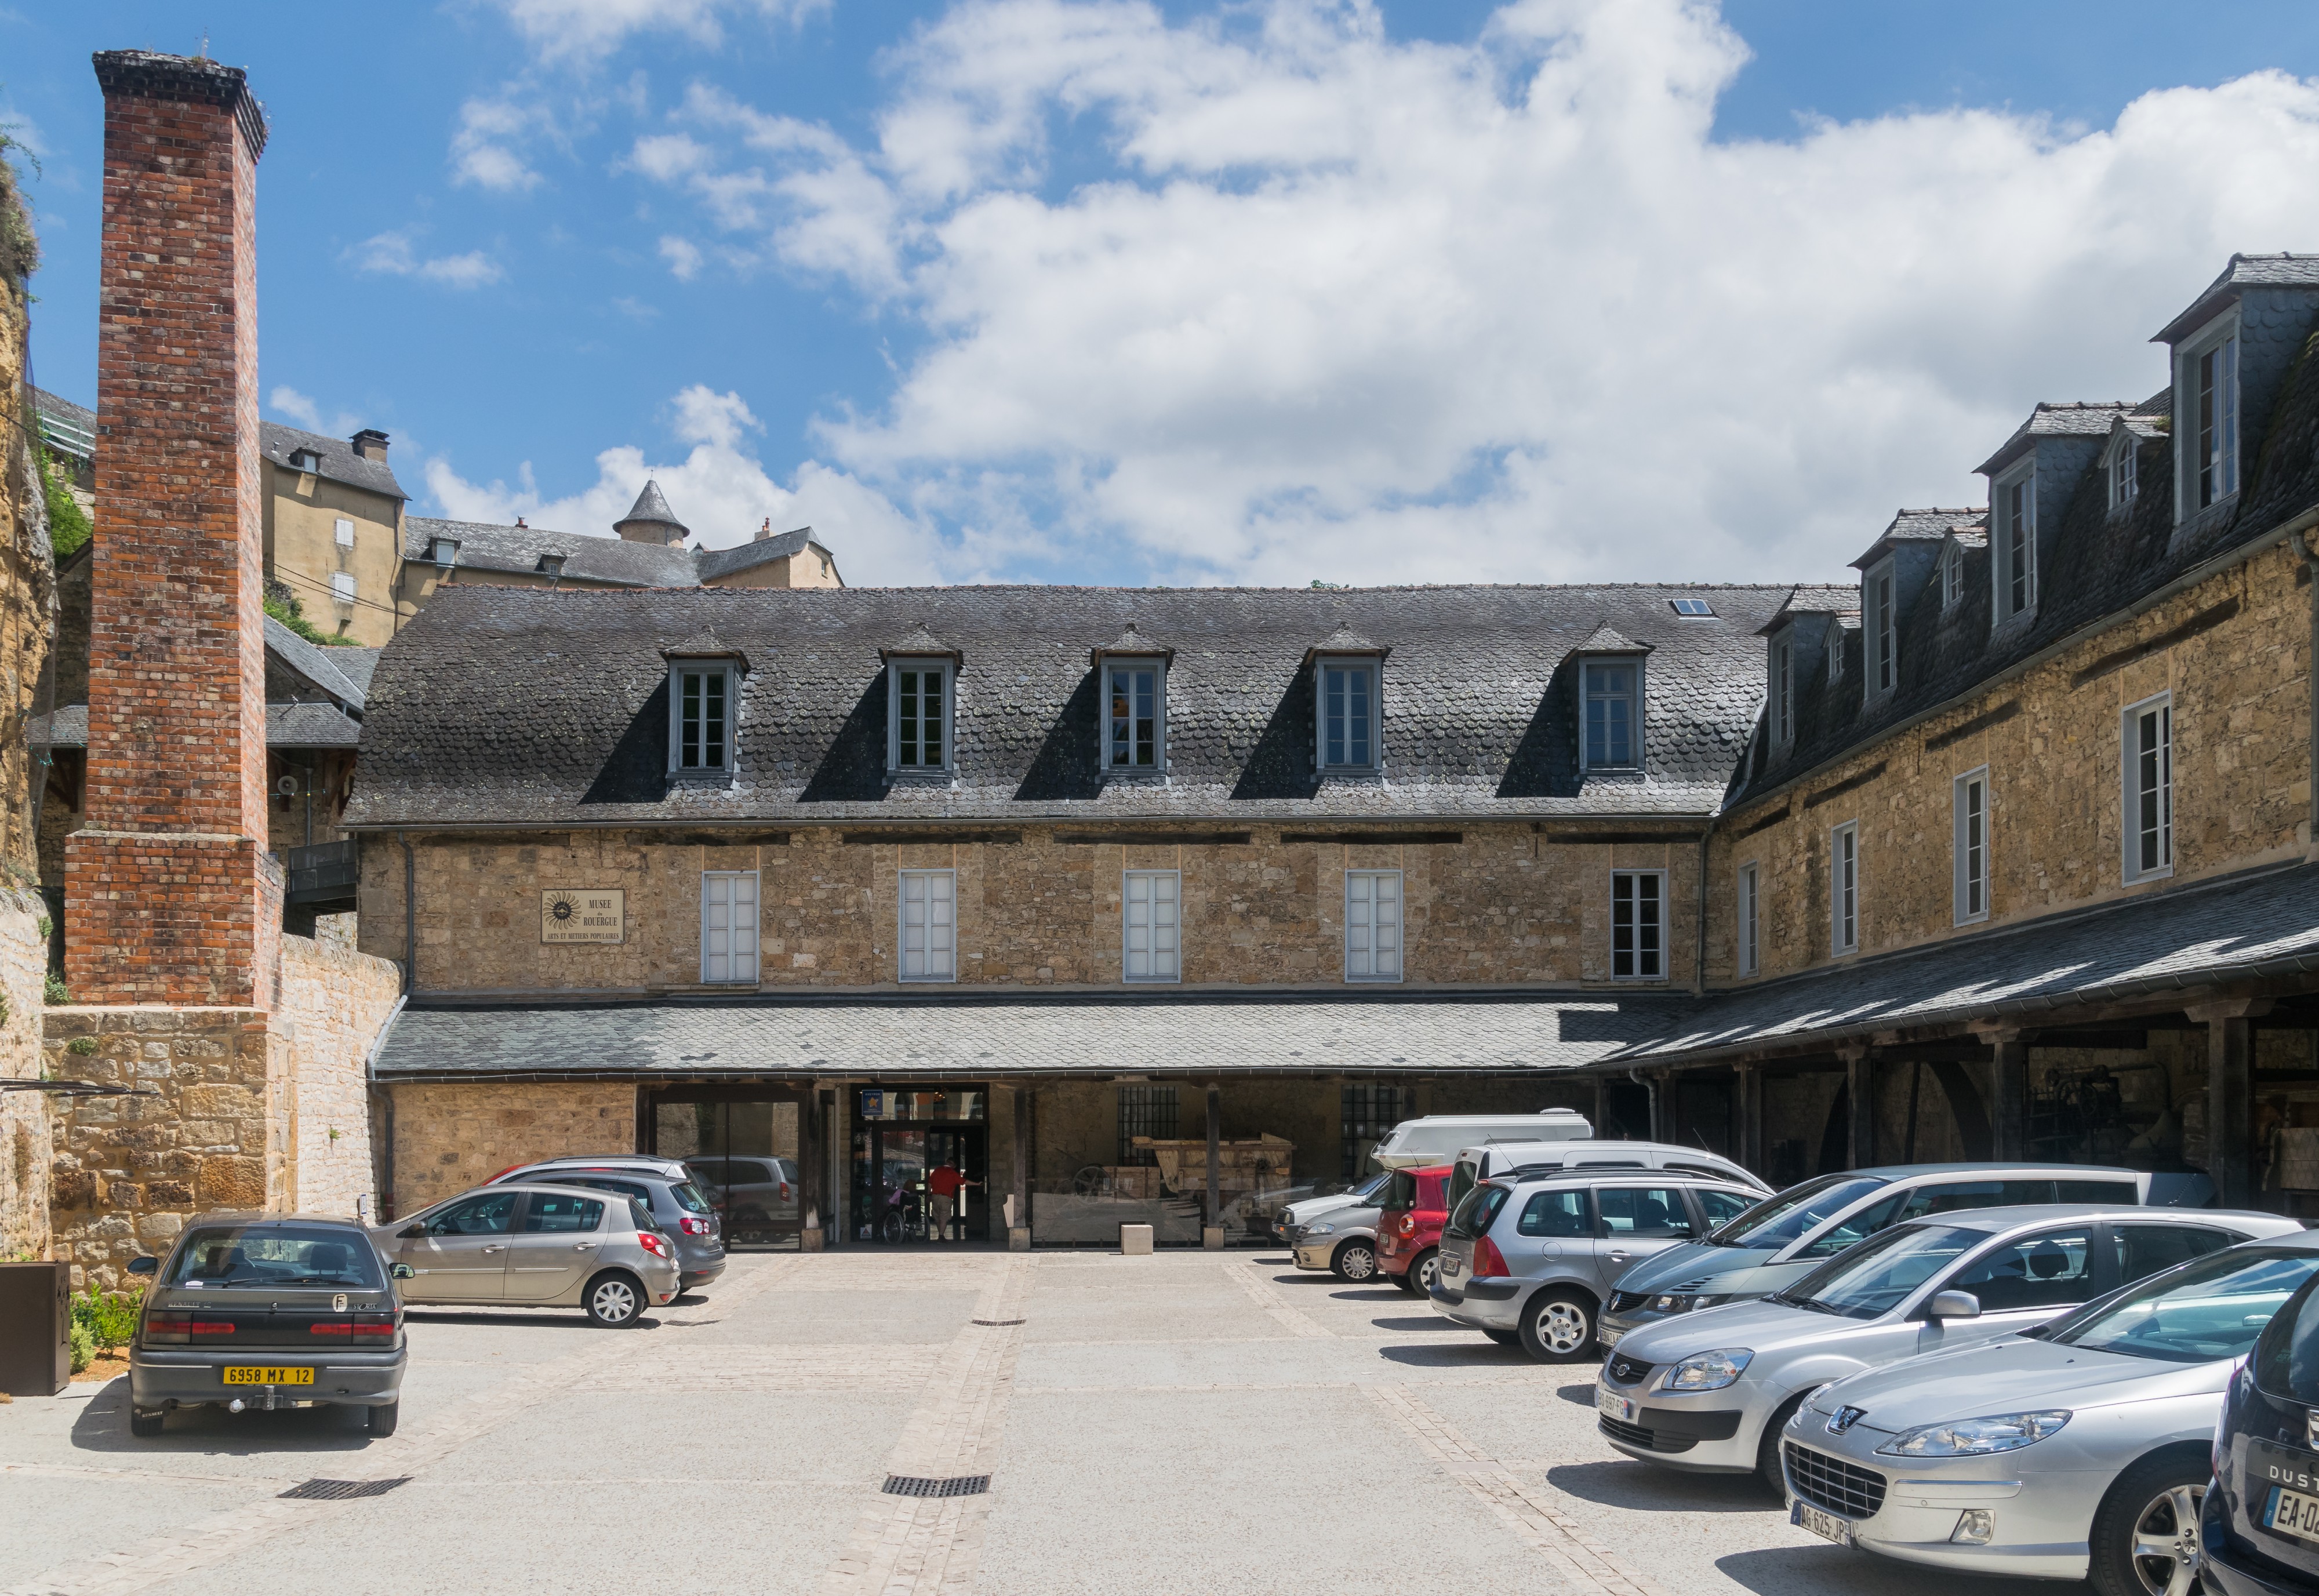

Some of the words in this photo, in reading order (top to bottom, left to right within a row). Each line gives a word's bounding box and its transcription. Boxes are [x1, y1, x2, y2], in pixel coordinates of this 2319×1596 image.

[588, 899, 612, 908] MUSEE
[583, 917, 617, 926] ROUERGUE
[230, 1369, 261, 1383] 6958
[267, 1369, 285, 1383] MX
[296, 1369, 310, 1383] 12
